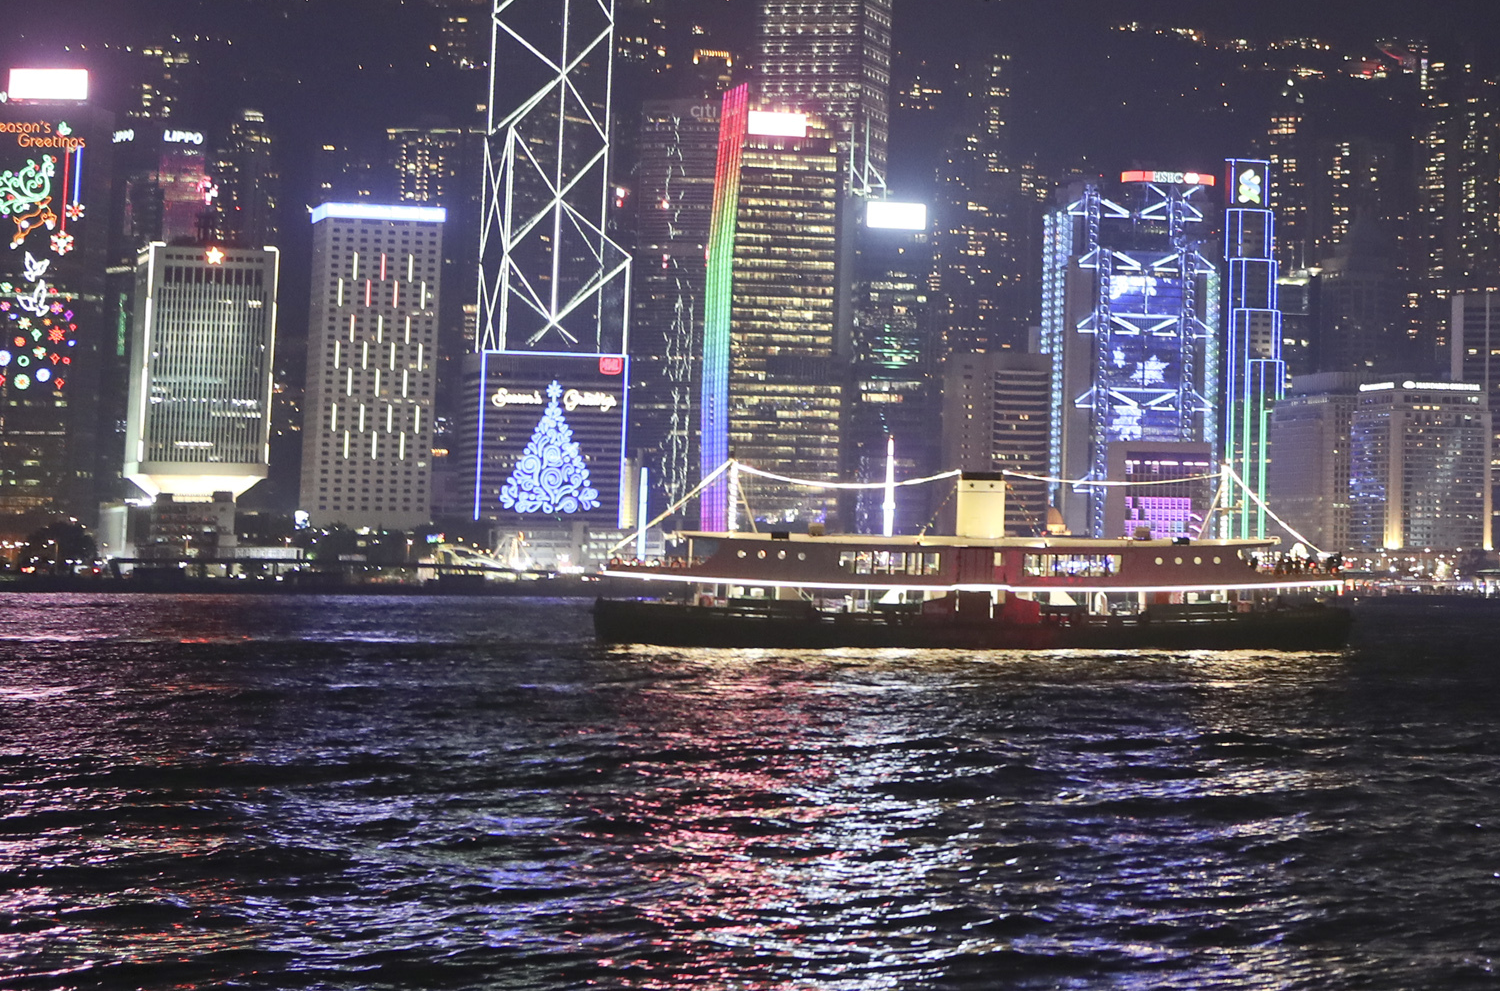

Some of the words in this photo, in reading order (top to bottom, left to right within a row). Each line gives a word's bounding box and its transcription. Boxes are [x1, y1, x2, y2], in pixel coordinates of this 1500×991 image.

[17, 133, 86, 151] Greetings
[163, 130, 204, 145] LIPPO
[1152, 171, 1184, 184] HSBC
